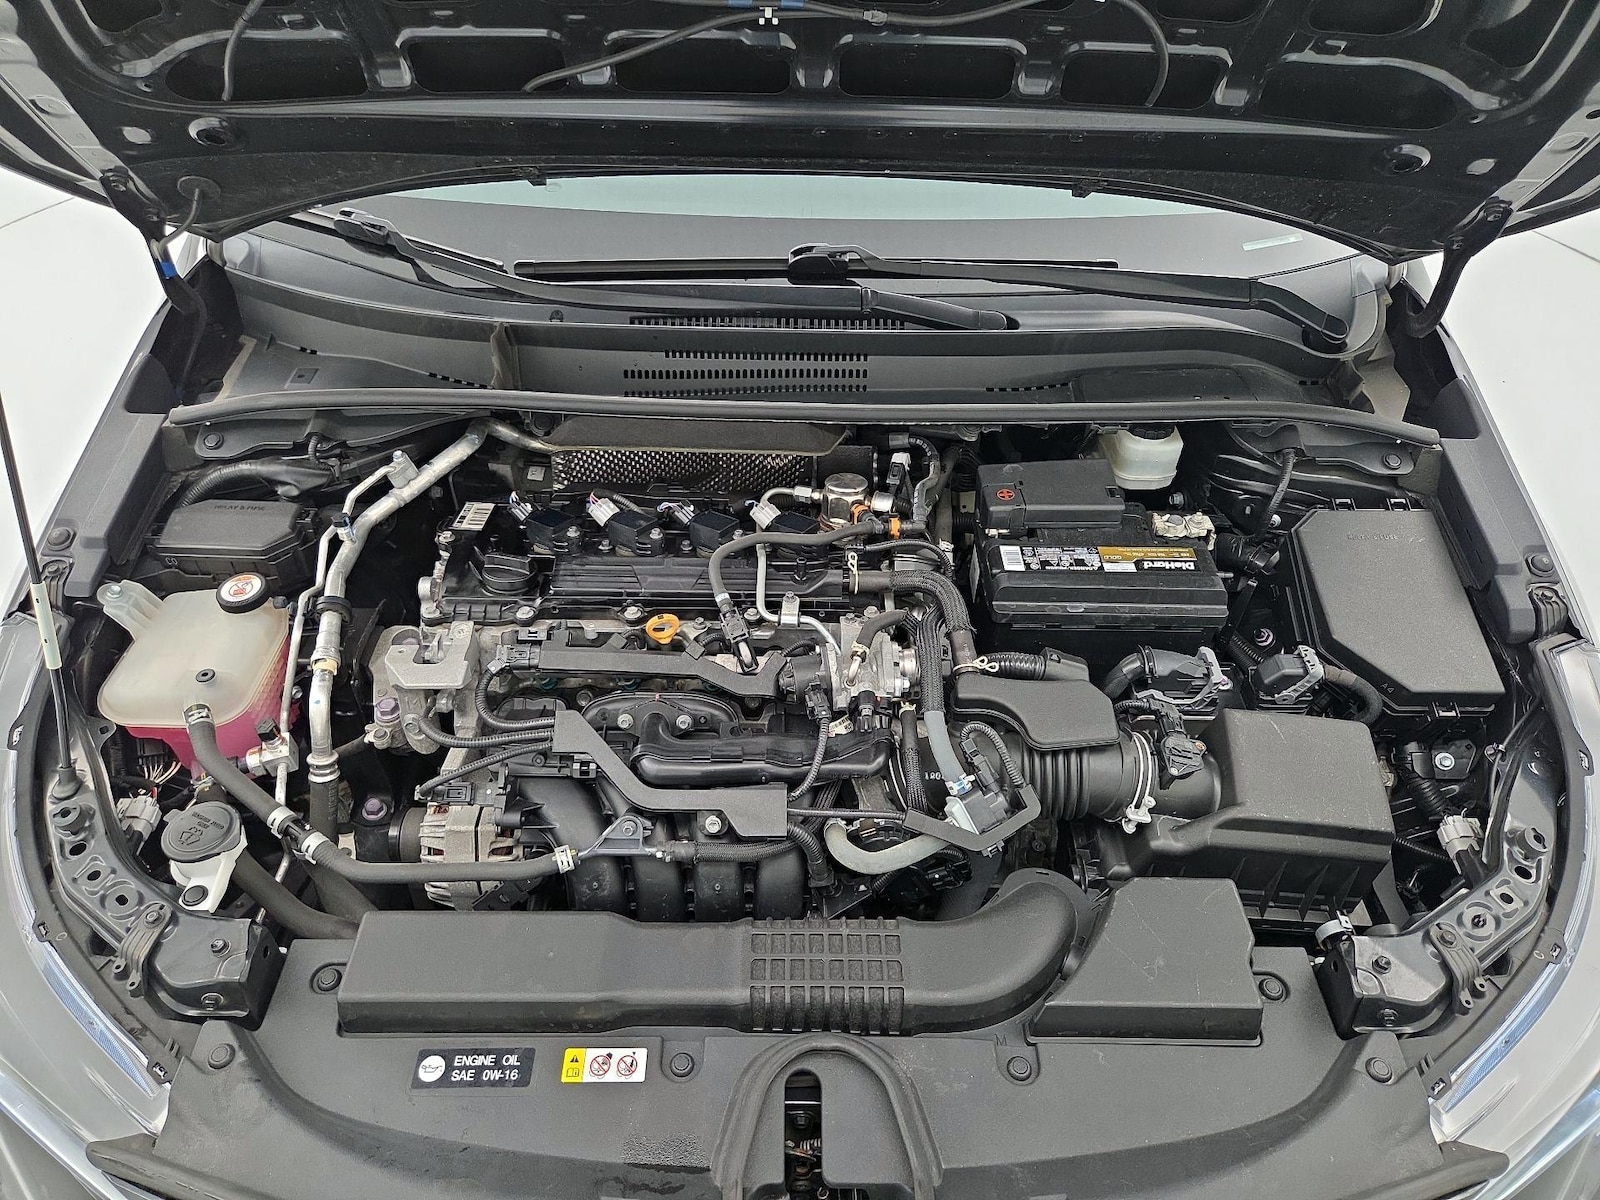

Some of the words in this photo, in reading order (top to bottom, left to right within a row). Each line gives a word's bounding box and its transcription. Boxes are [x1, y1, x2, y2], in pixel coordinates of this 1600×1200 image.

[1143, 561, 1195, 570] DieHard
[453, 1055, 496, 1066] ENGINE
[502, 1055, 521, 1065] OIL
[451, 1069, 475, 1081] SAE
[483, 1069, 518, 1081] 0W-16
